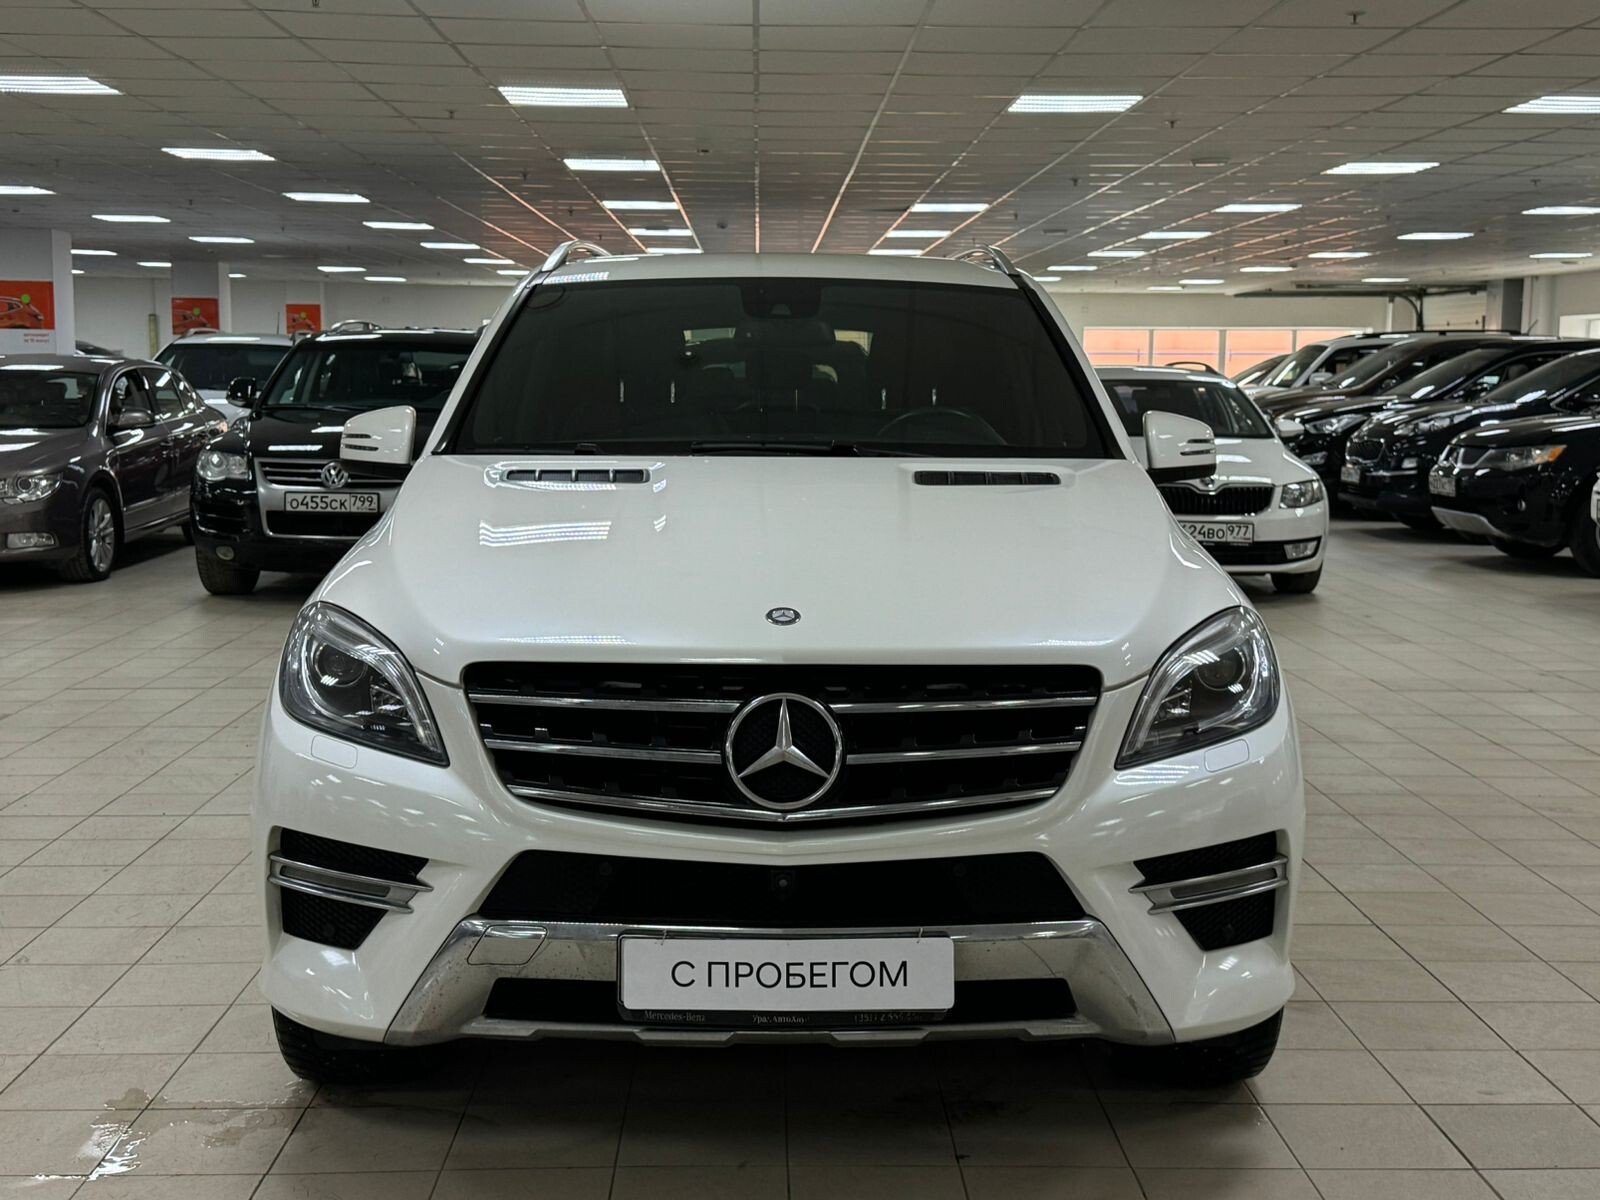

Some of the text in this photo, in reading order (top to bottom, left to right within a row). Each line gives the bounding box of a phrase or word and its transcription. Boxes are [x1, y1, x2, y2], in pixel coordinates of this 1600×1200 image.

[289, 495, 374, 510] О455СК 799
[1182, 524, 1249, 539] 24ВО 977
[671, 960, 908, 989] С ПРОБЕГОМ
